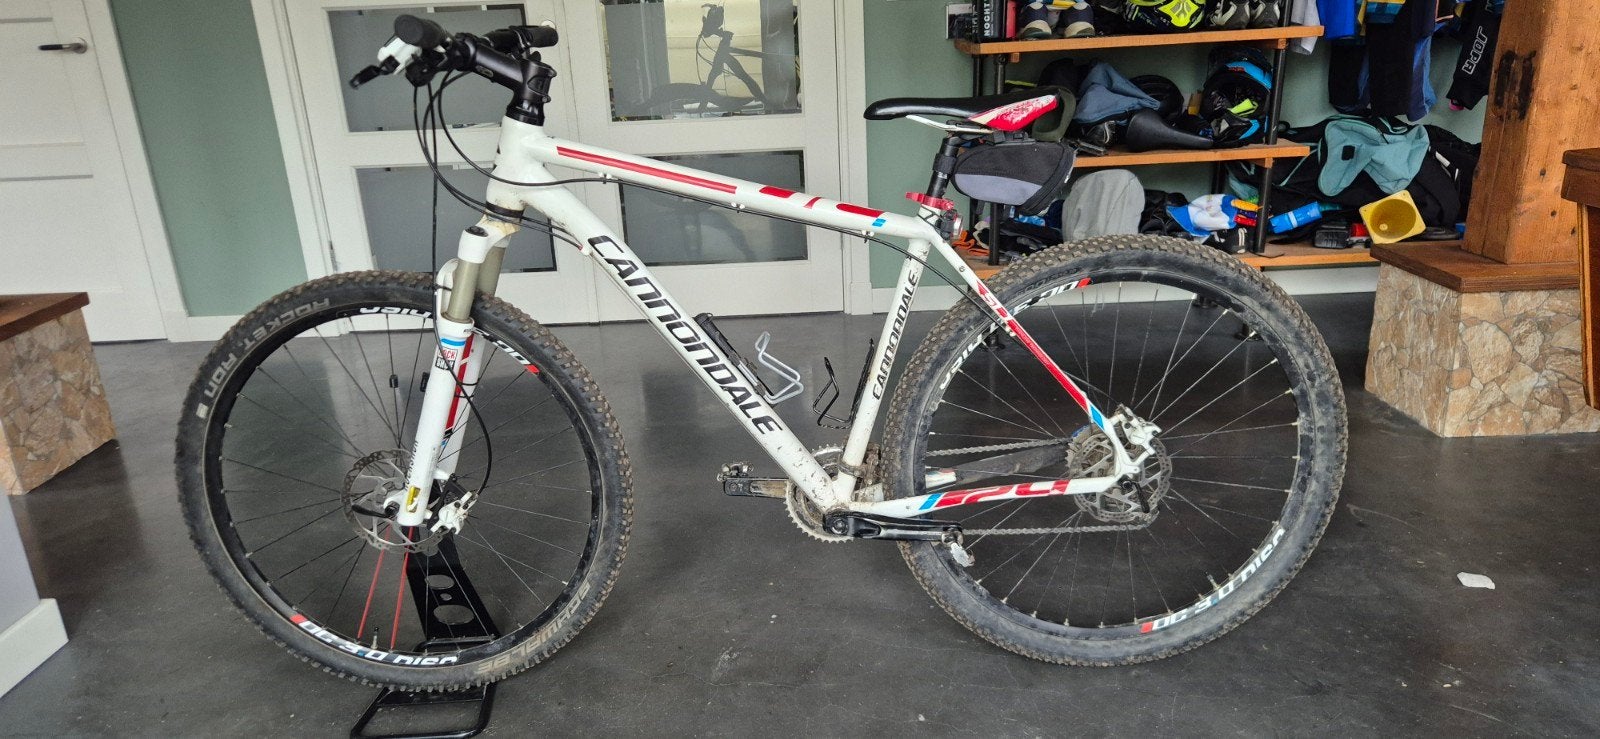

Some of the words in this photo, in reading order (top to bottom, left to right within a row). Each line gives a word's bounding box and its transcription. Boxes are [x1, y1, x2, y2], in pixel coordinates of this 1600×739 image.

[1461, 25, 1488, 75] JOPA
[243, 297, 331, 350] ROCKET
[587, 235, 784, 435] CANNONDALE
[872, 270, 919, 400] CANNONDALE
[204, 352, 239, 398] RON
